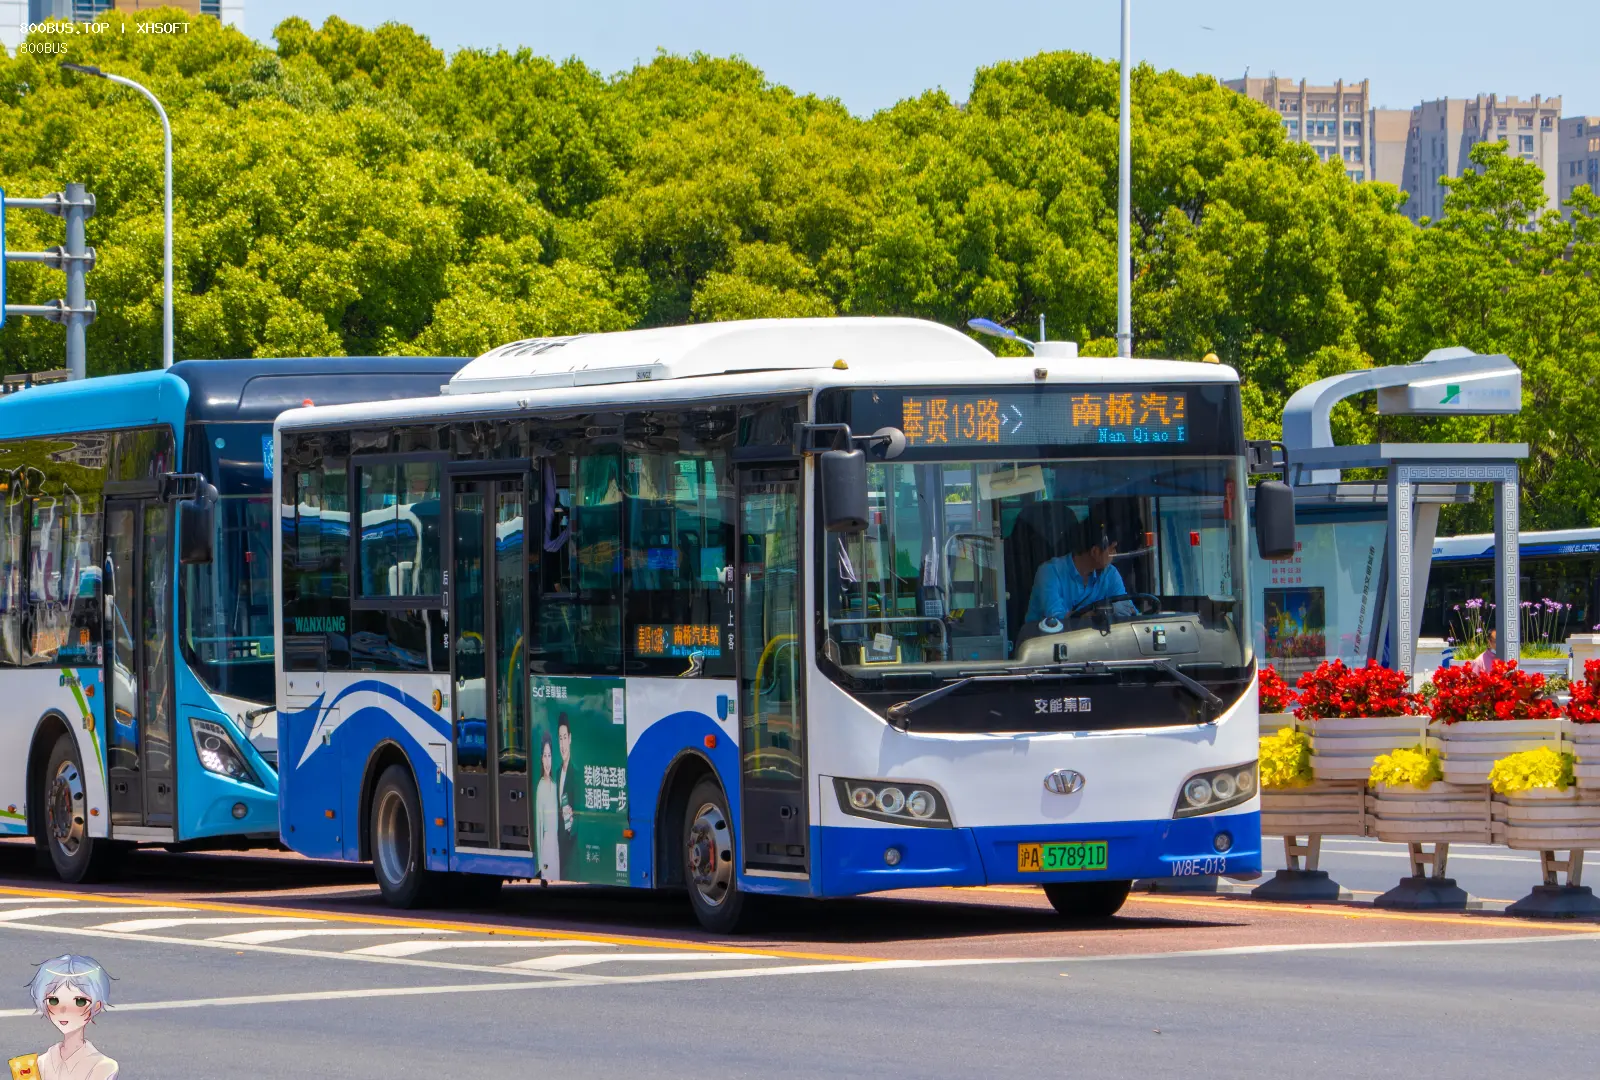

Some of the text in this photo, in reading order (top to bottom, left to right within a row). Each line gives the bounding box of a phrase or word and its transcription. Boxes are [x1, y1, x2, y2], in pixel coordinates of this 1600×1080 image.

[903, 398, 1000, 445] 奉贤13路
[1098, 428, 1126, 443] Nan
[1133, 427, 1168, 443] Qiao
[295, 616, 346, 632] WANXIANG
[673, 624, 719, 646] 南桥汽车站
[1034, 697, 1092, 714] 交能集团
[584, 765, 626, 788] 装修选圣都
[585, 788, 627, 811] 透明每一步
[1020, 845, 1106, 867] 沪A 57891D
[1171, 856, 1226, 877] W8E-013
